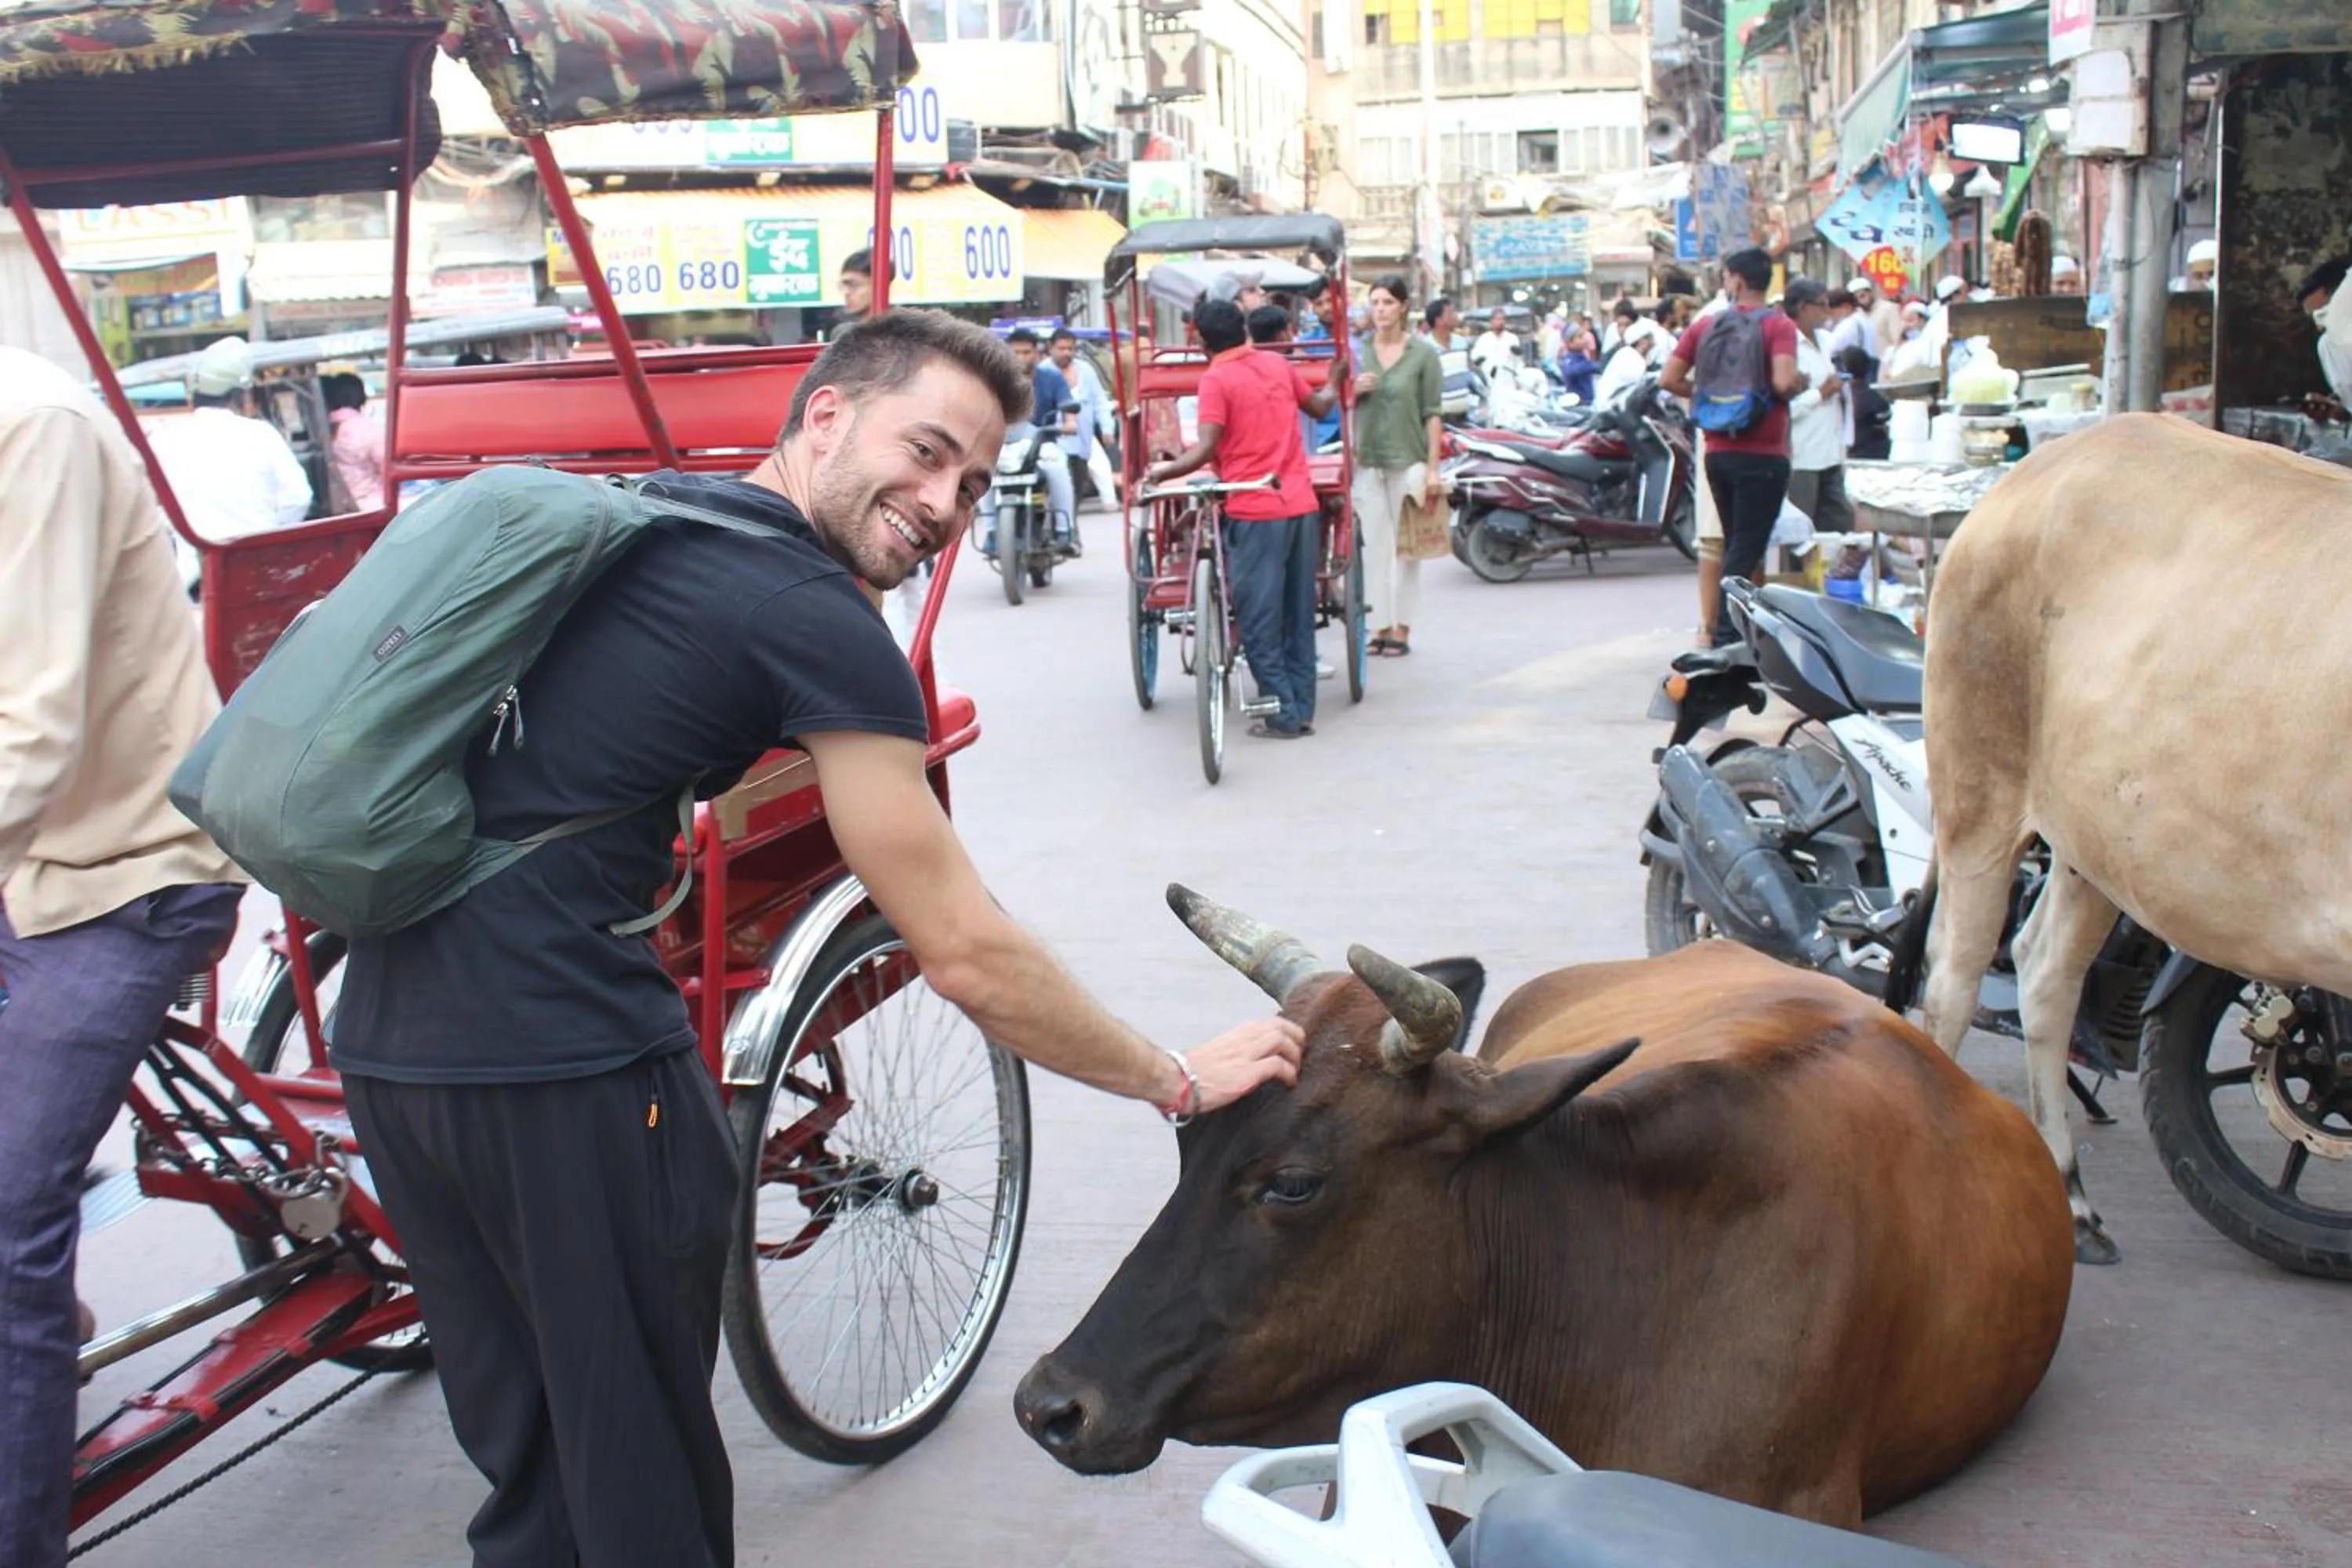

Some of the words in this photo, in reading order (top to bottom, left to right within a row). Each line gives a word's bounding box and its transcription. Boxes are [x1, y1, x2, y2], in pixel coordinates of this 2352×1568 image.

[965, 225, 1011, 280] 600
[606, 264, 662, 303] 680
[679, 260, 739, 291] 680
[376, 632, 403, 655] OSPREY
[1852, 737, 1913, 793] Apache
